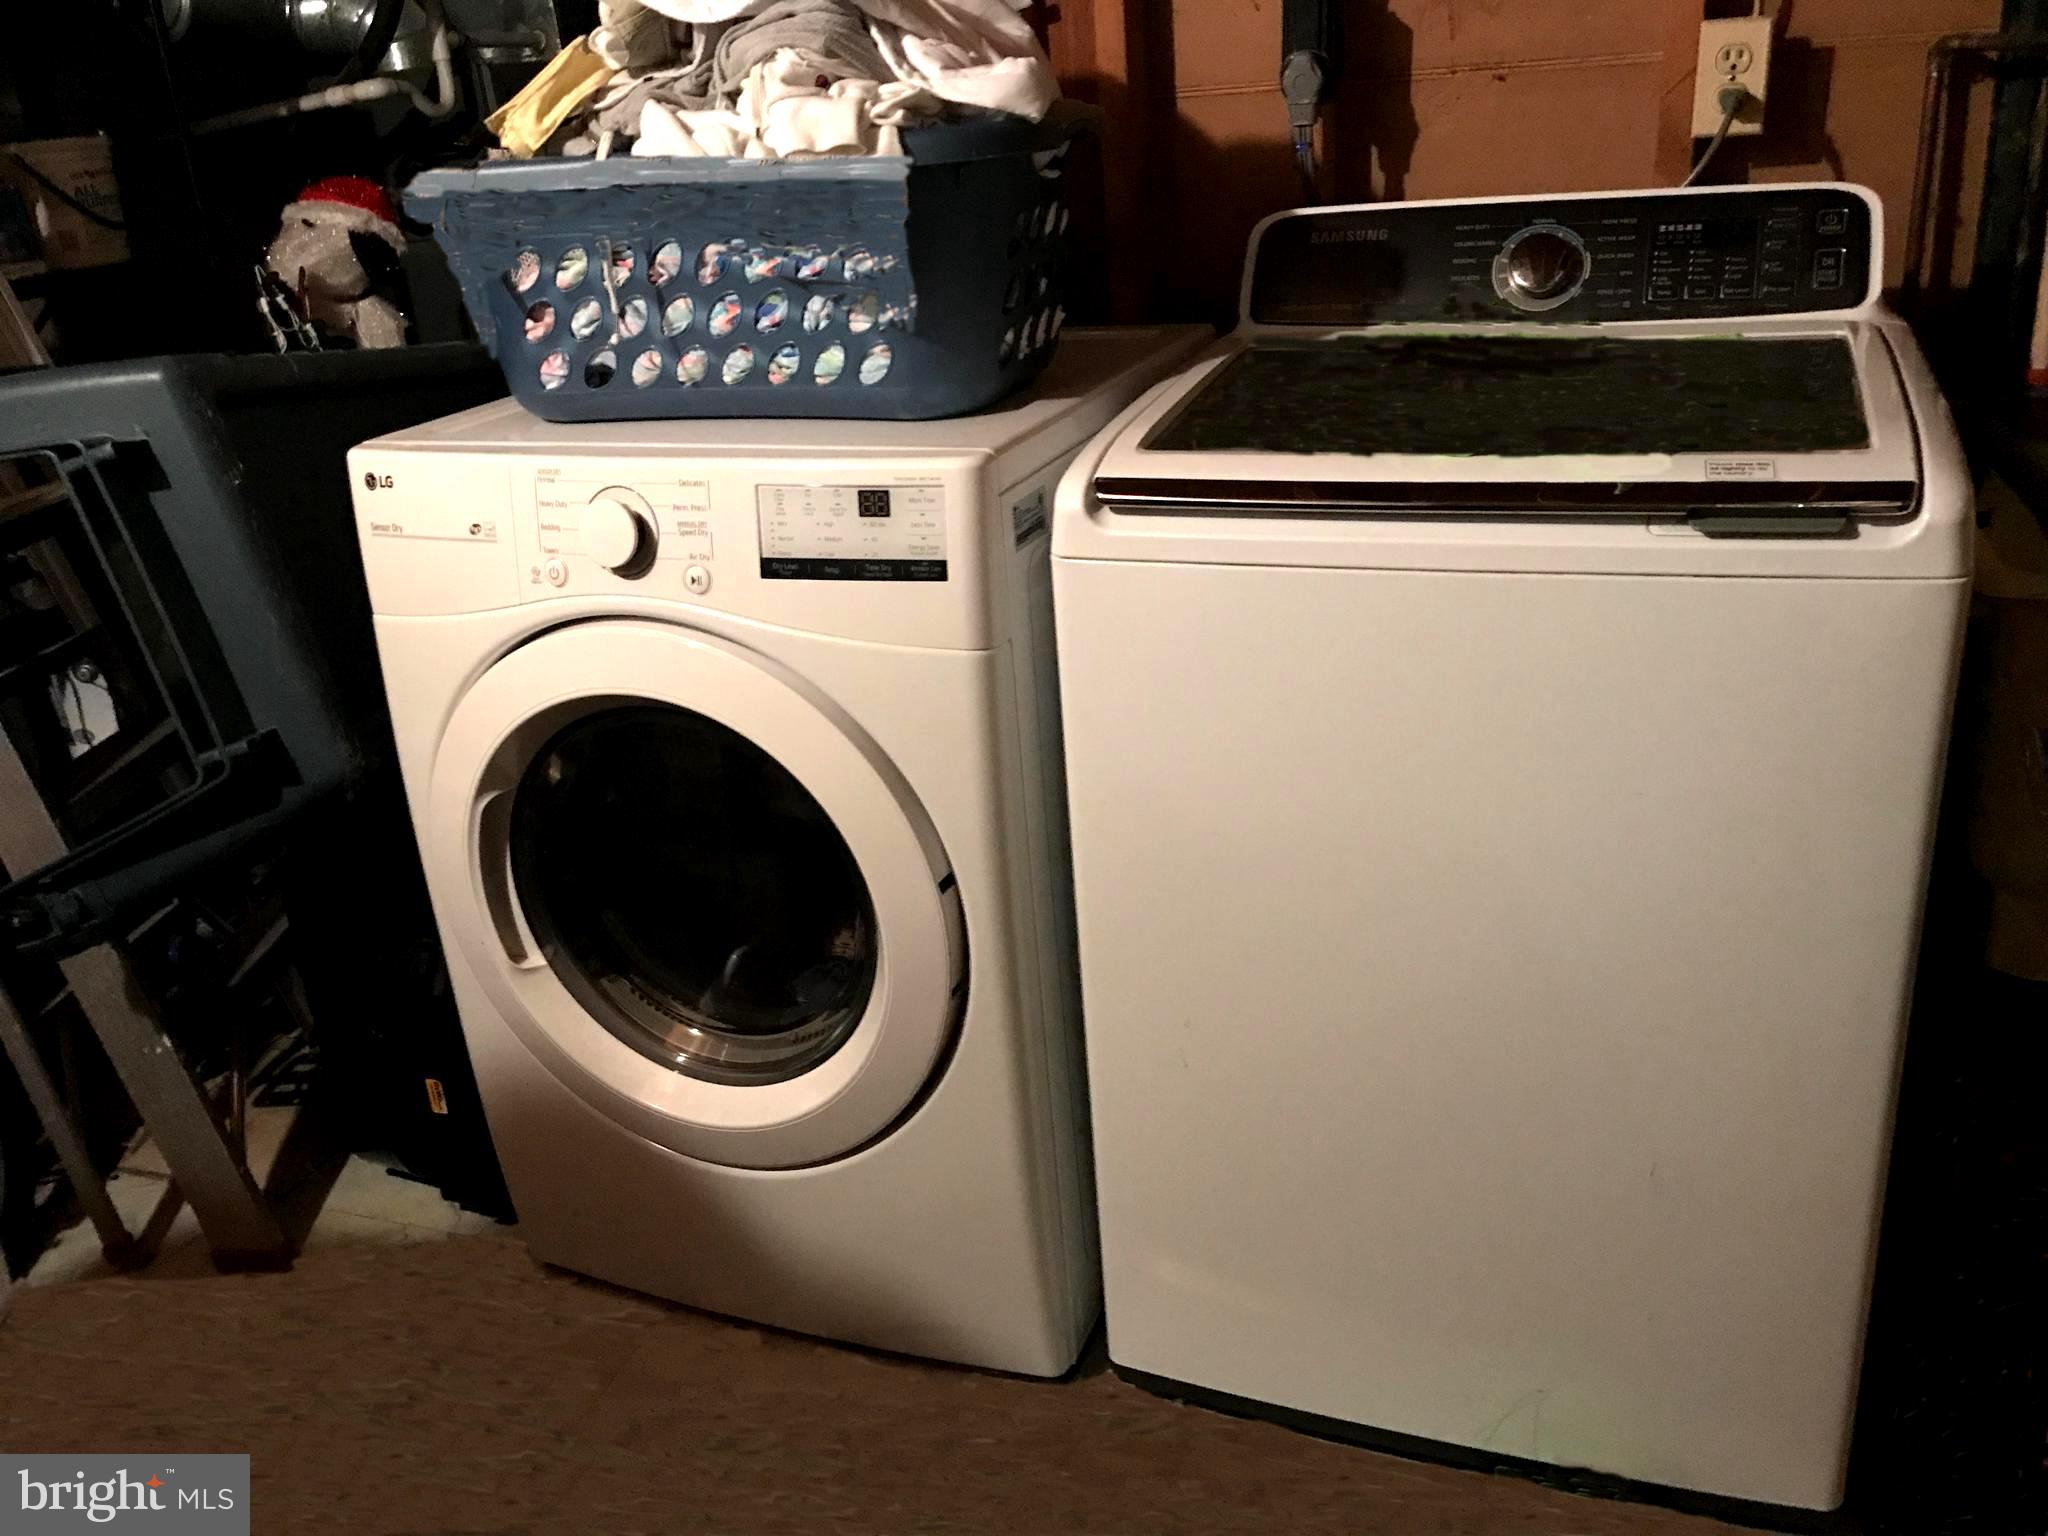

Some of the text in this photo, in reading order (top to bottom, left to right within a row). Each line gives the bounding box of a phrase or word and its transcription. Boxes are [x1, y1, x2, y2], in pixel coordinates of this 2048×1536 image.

[1311, 228, 1389, 243] SAMSUNG
[379, 475, 393, 488] LG
[392, 523, 403, 534] Dry
